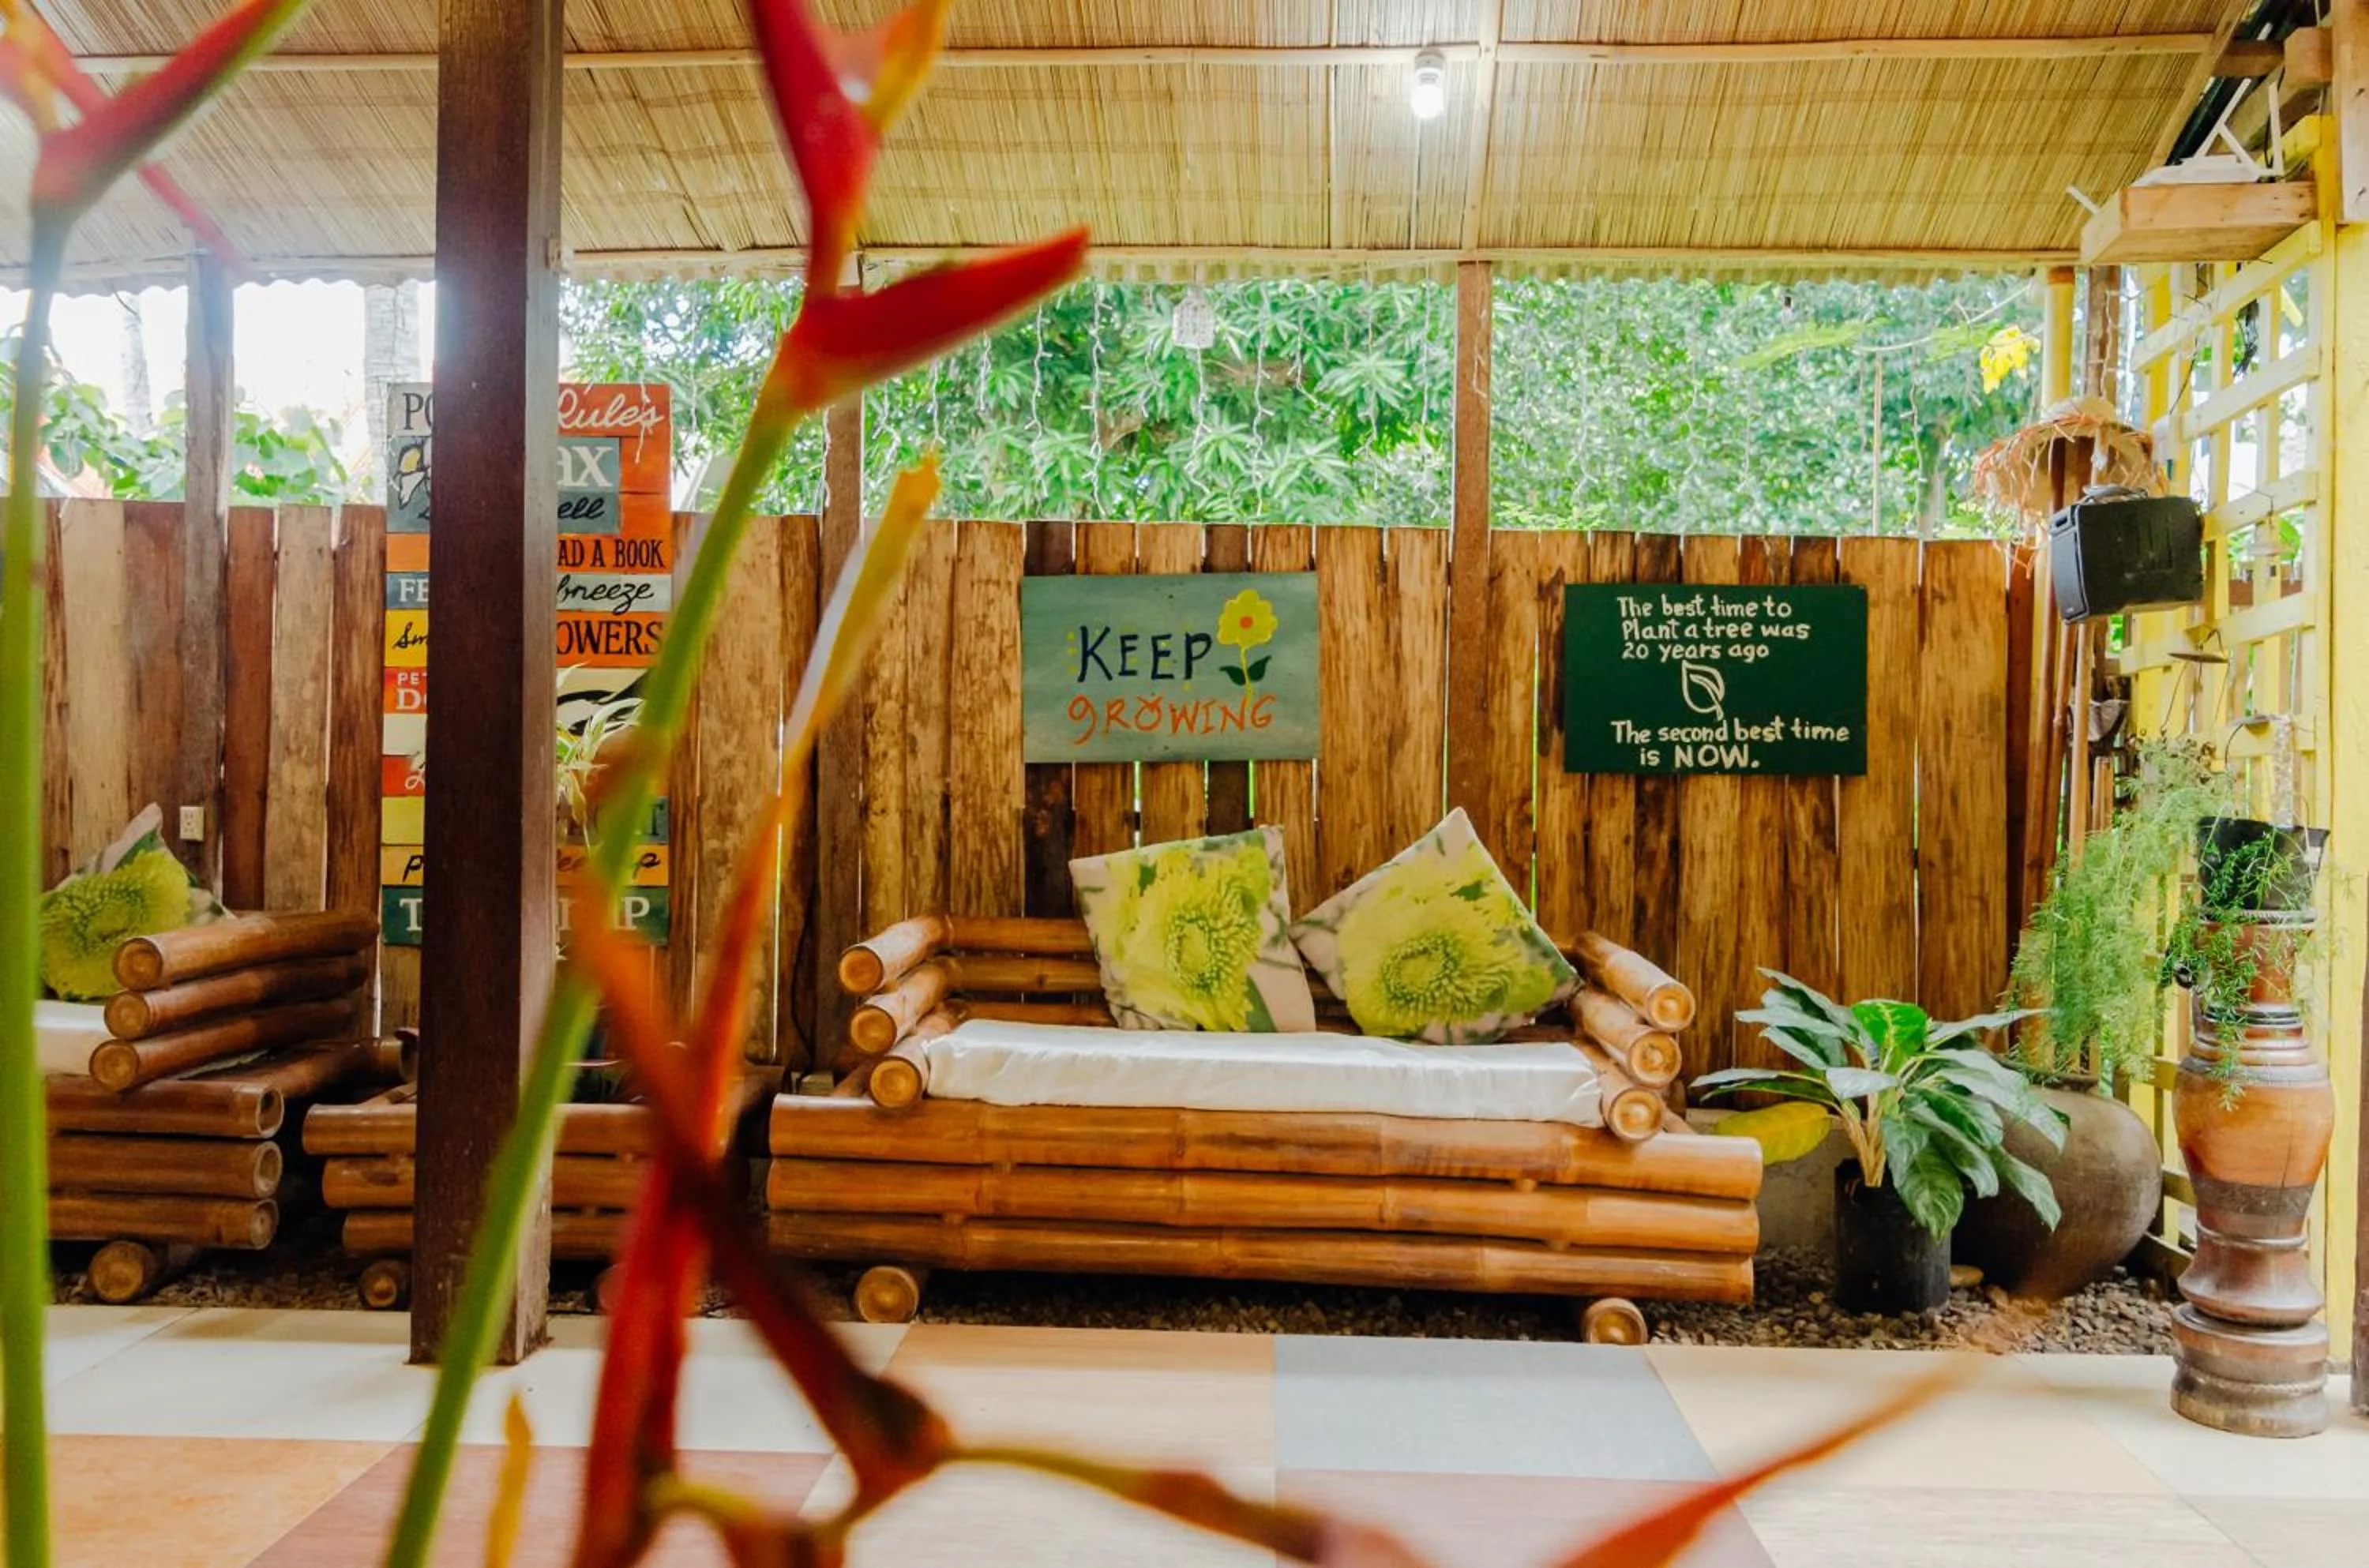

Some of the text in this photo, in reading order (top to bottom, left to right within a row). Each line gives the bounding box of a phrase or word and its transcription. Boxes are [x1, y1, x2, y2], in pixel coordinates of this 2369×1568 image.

[557, 538, 666, 569] AD A BOOK
[1616, 593, 1793, 618] The best time to
[557, 620, 663, 655] OWERS
[1621, 617, 1811, 640] Plant a tree was
[1076, 625, 1213, 683] KEEP
[1621, 642, 1770, 663] 20 years ago
[1610, 715, 1851, 744] The second best time
[1639, 744, 1761, 769] is NOW.
